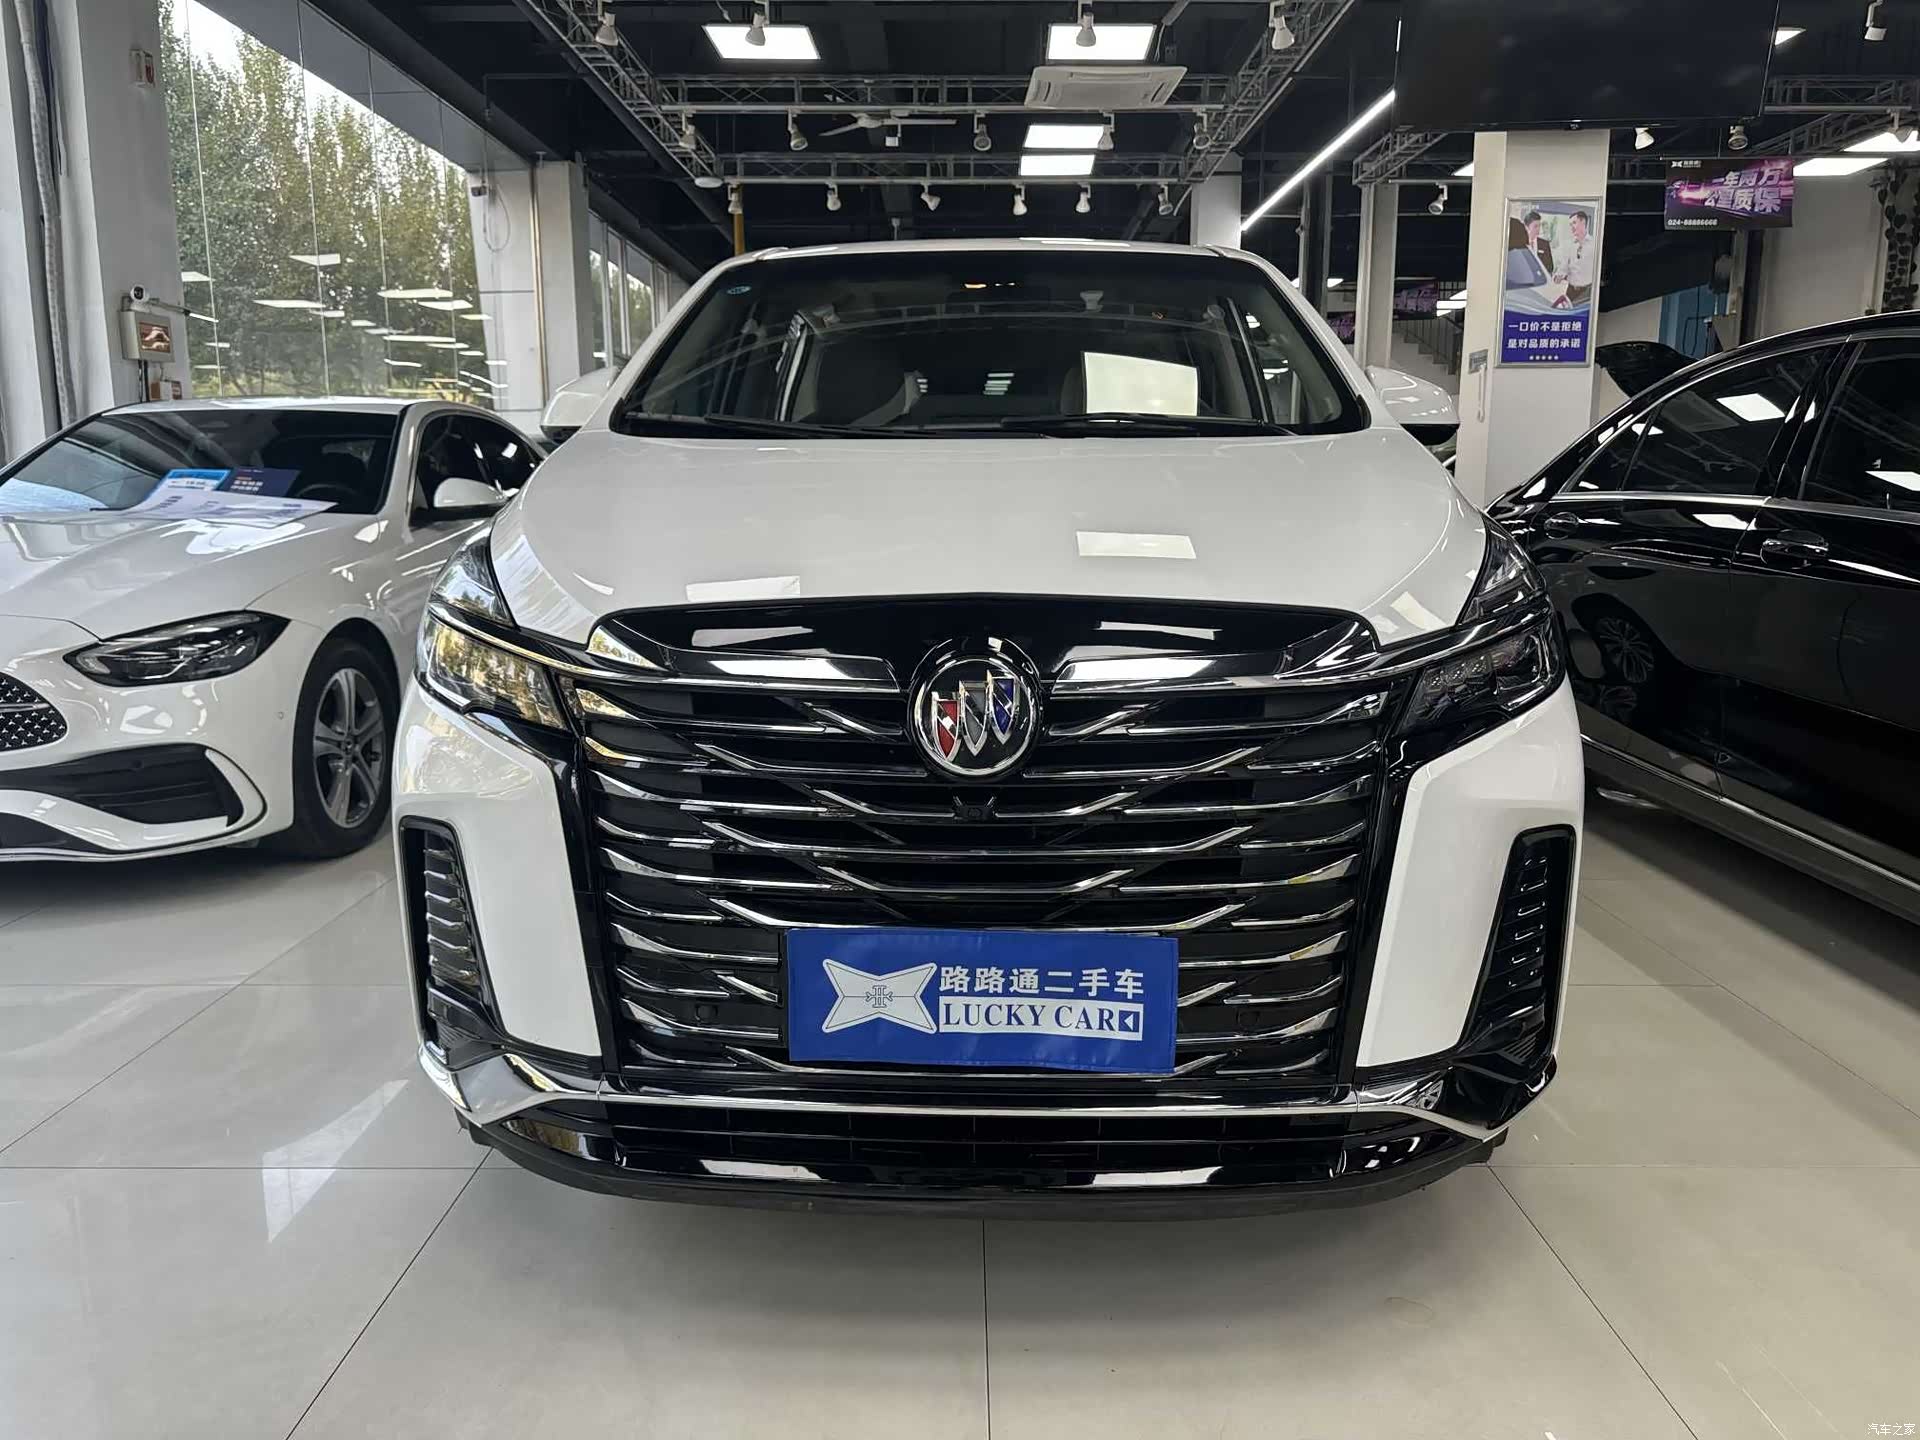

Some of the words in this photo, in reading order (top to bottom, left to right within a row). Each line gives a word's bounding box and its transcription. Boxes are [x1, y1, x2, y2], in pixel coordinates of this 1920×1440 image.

[1508, 321, 1582, 332] 一口价不是拒绝
[1507, 338, 1581, 349] 是对品质的承诺
[939, 966, 1144, 1000] 路路通二手车
[942, 1003, 1045, 1028] LUCKY
[1054, 1005, 1115, 1031] CAR
